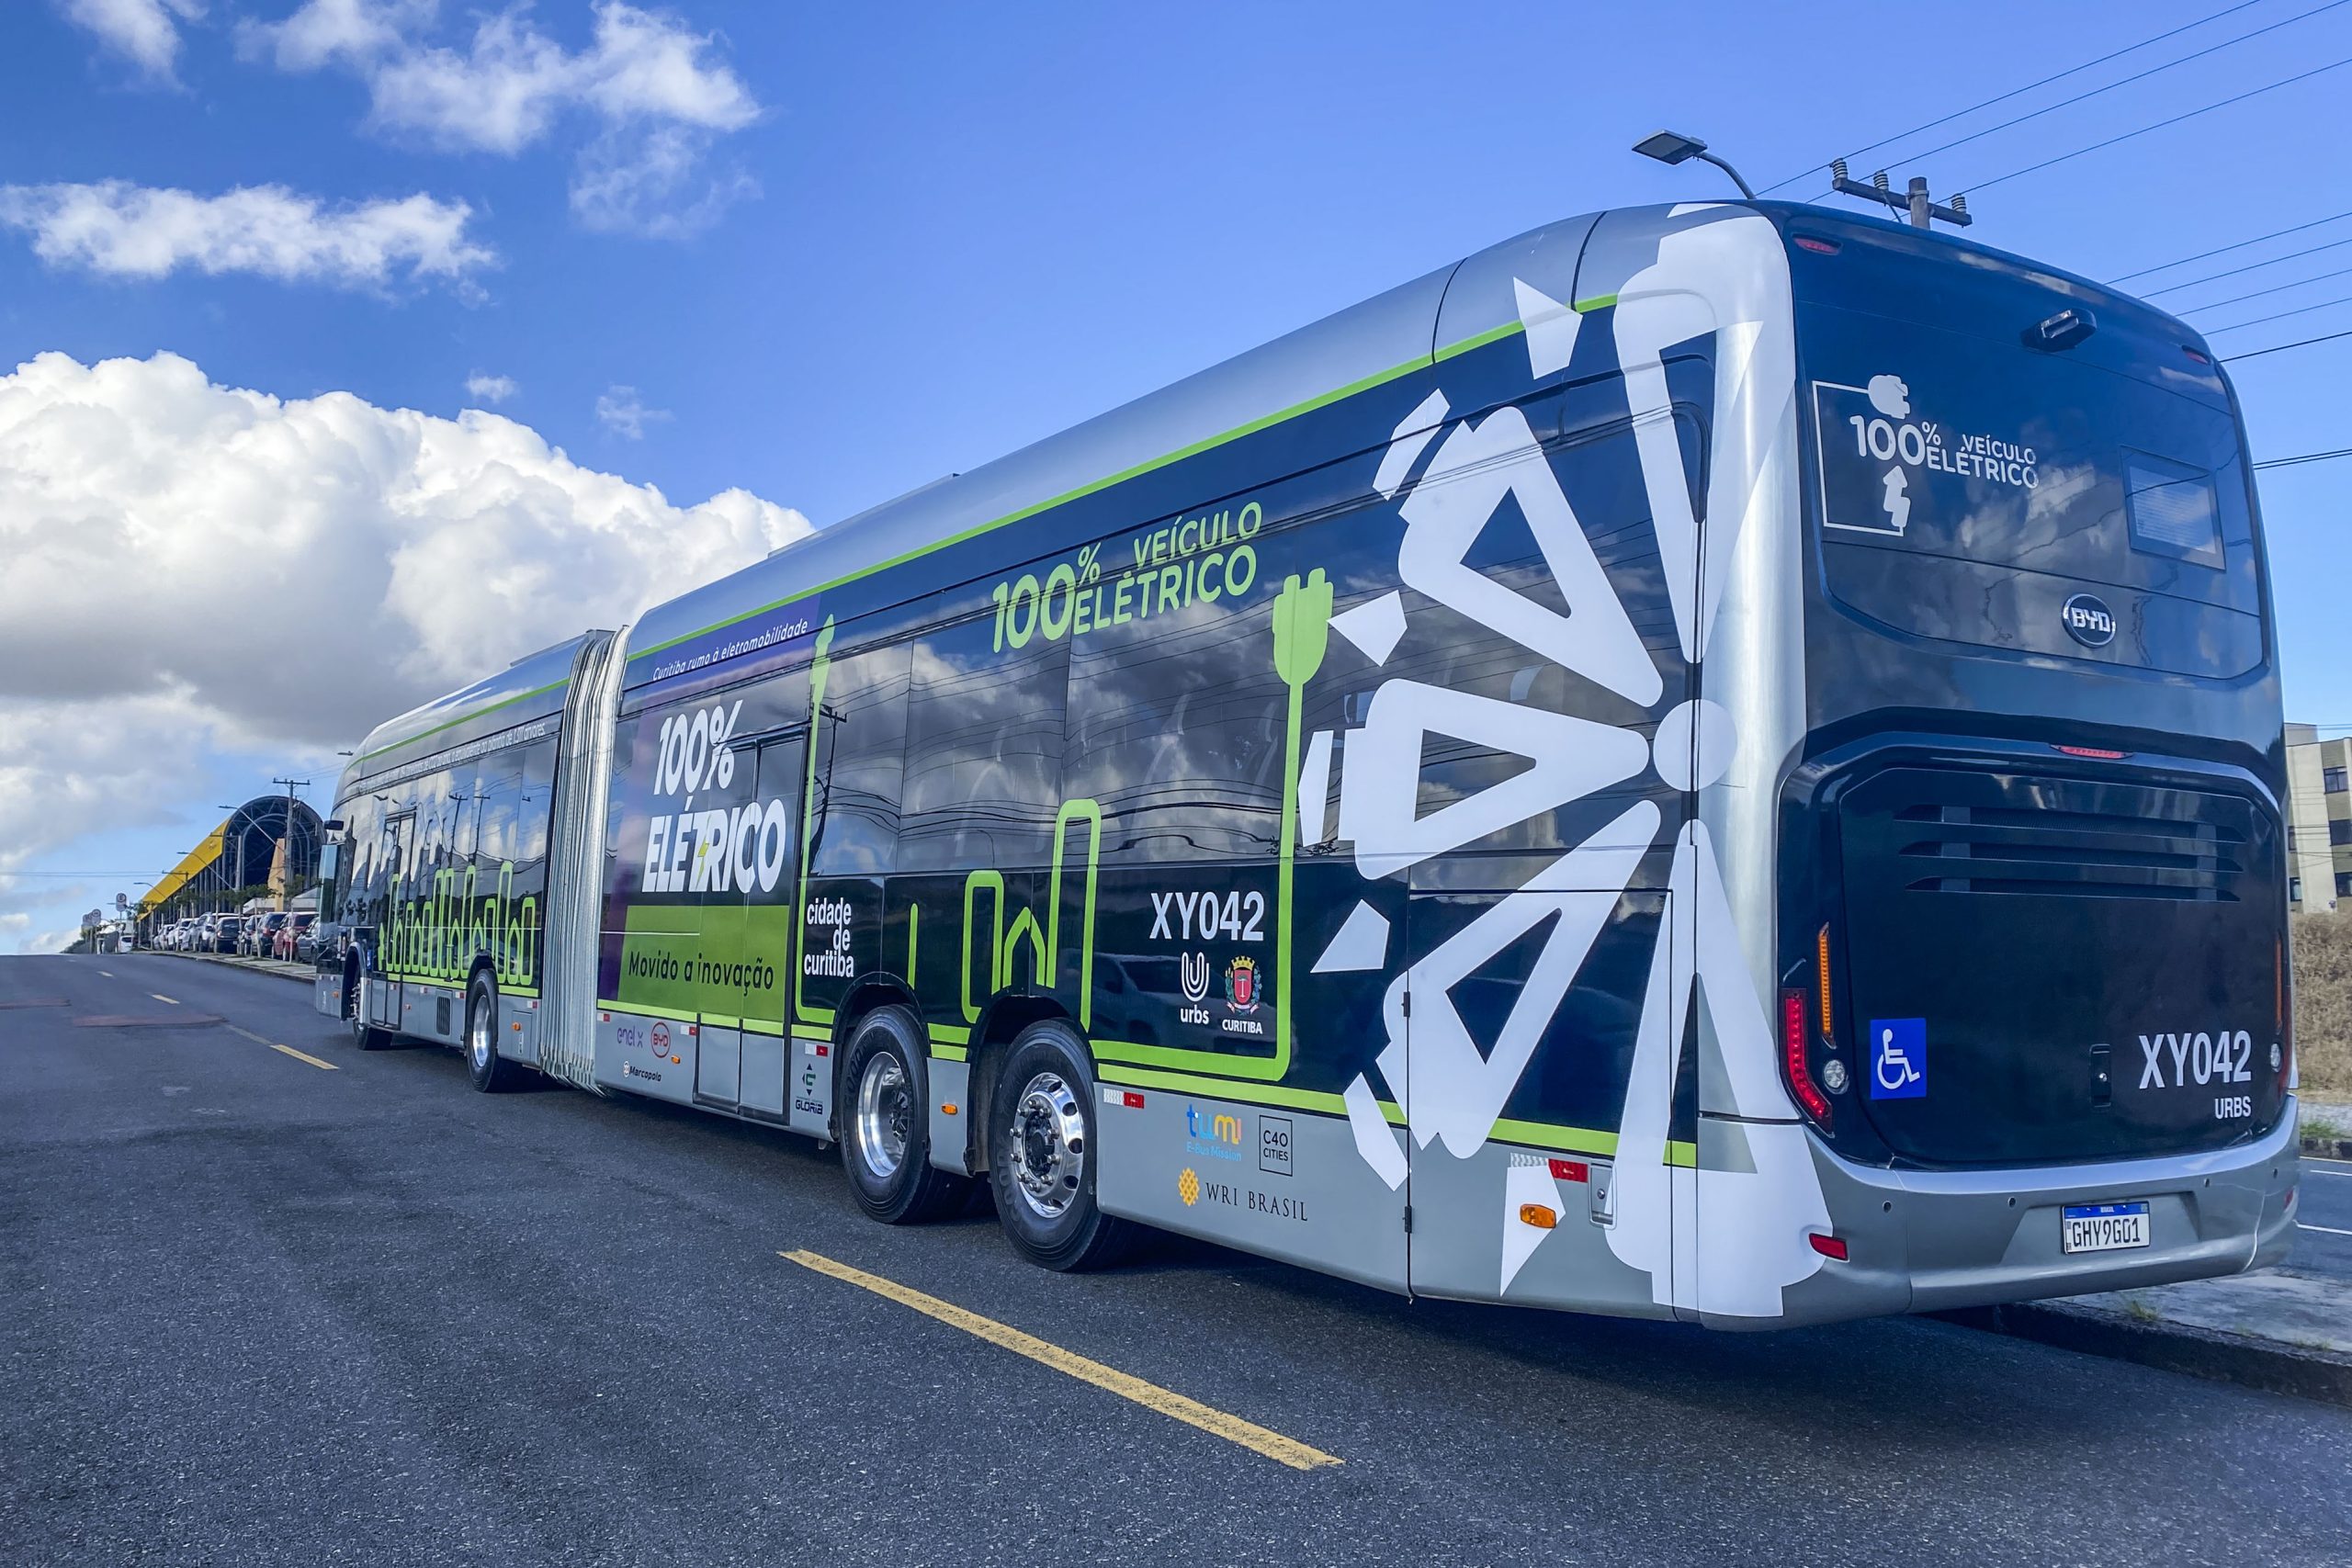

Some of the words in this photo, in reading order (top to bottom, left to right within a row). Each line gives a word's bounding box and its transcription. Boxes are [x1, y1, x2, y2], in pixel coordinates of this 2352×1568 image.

[1849, 415, 1941, 466] 100%
[1962, 434, 2037, 465] VEÍCULO
[1927, 446, 2040, 490] ELÉTRICO
[1134, 501, 1262, 569] VEÍCULO
[992, 541, 1102, 653] 100%
[1073, 545, 1258, 636] ELÉTRICO
[2071, 607, 2111, 634] BYD
[653, 660, 686, 681] Curitiba
[688, 652, 710, 670] rumo
[713, 648, 719, 661] à
[721, 618, 808, 659] eletromobilidade
[653, 700, 743, 795] 100%
[641, 795, 786, 894] ELÉTRICO
[806, 897, 852, 925] cidade
[1148, 890, 1265, 942] XY042
[832, 925, 851, 951] de
[628, 950, 678, 981] Movido
[684, 961, 693, 982] a
[696, 953, 774, 997] inovação
[804, 950, 854, 977] curitiba
[1180, 1004, 1210, 1025] urbs
[1222, 1019, 1263, 1034] CURITIBA
[616, 1025, 636, 1046] enel
[652, 1032, 669, 1047] BYD
[629, 1066, 662, 1082] Marcopolo
[2138, 1030, 2252, 1090] XY042
[2214, 1096, 2251, 1119] URBS
[1186, 1102, 1242, 1145] tumi
[1262, 1129, 1288, 1147] C40
[1262, 1147, 1289, 1162] CITIES
[1205, 1182, 1238, 1206] WRI
[1248, 1190, 1308, 1222] BRASIL
[2072, 1217, 2141, 1247] GHY9G01
